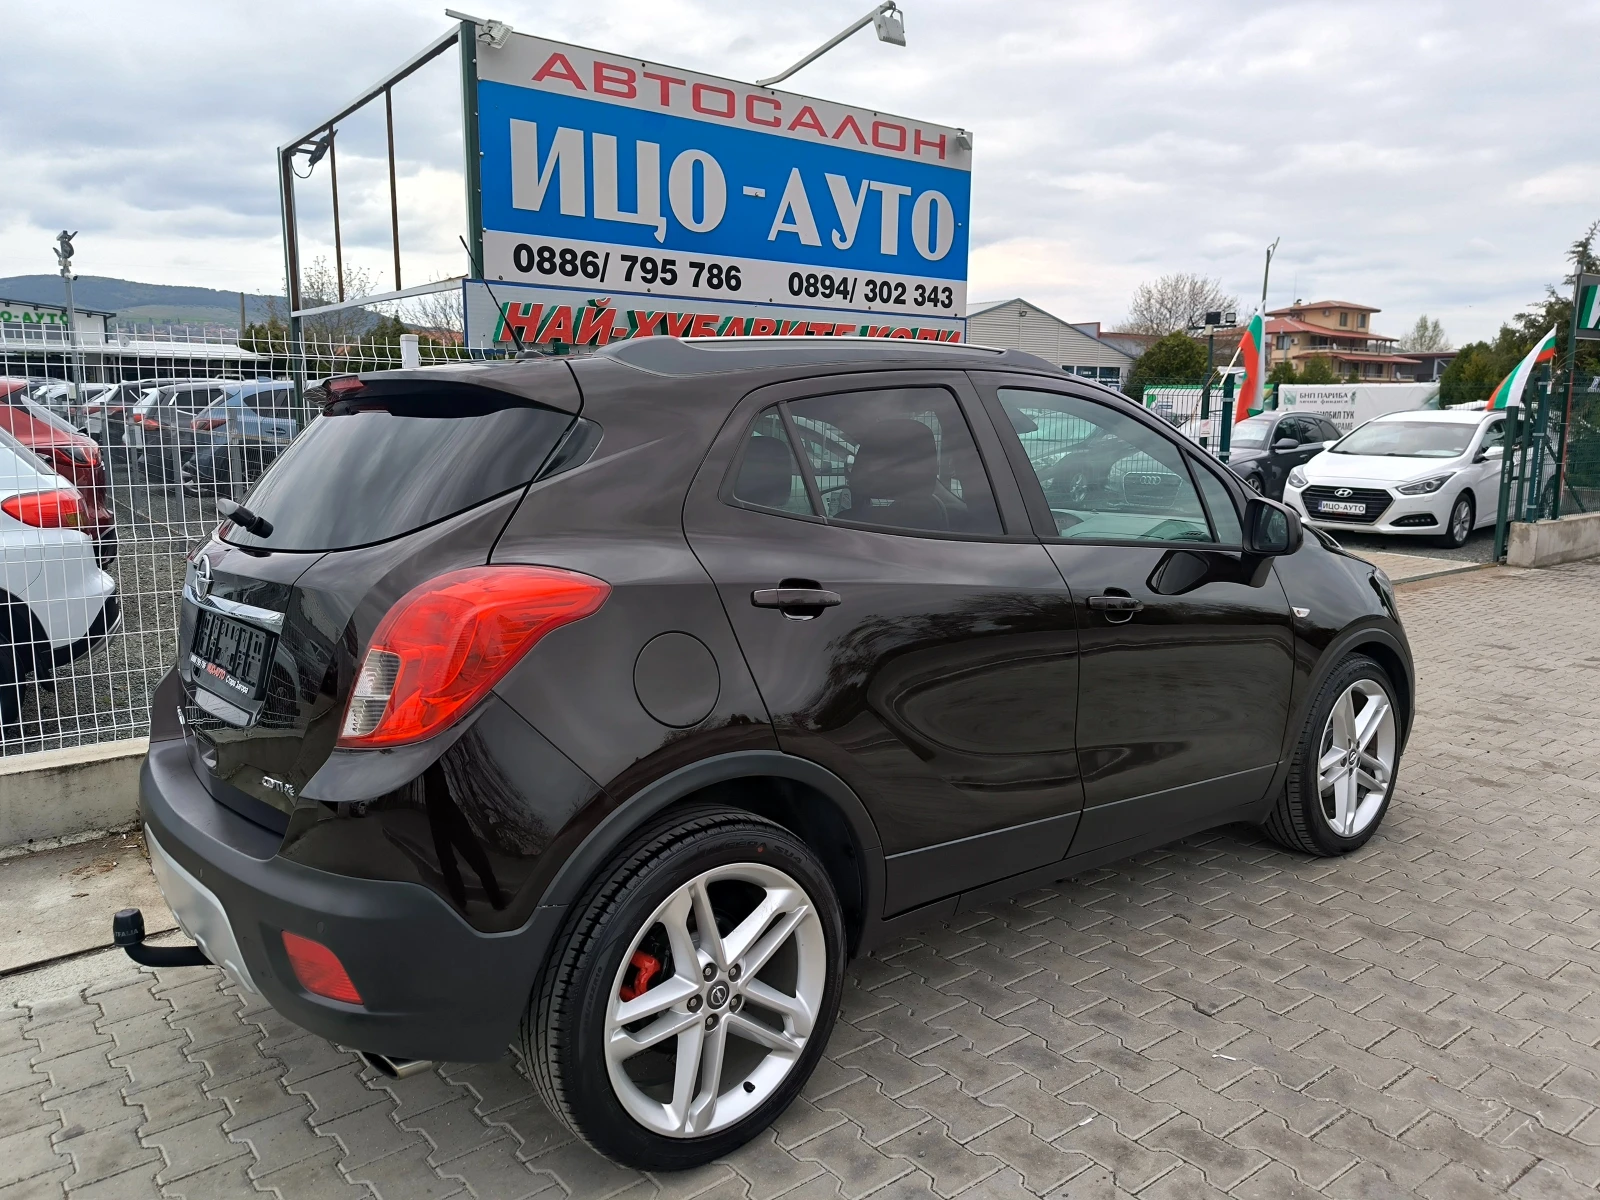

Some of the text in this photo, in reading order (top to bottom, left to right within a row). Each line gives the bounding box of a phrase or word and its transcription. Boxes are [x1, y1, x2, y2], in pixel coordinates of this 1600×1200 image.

[532, 52, 947, 161] АВТОСАЛОН
[513, 243, 742, 292] 0886/ 795 786
[788, 271, 954, 309] 0894/ 302 343
[1322, 503, 1365, 512] ИЦО-АУТО
